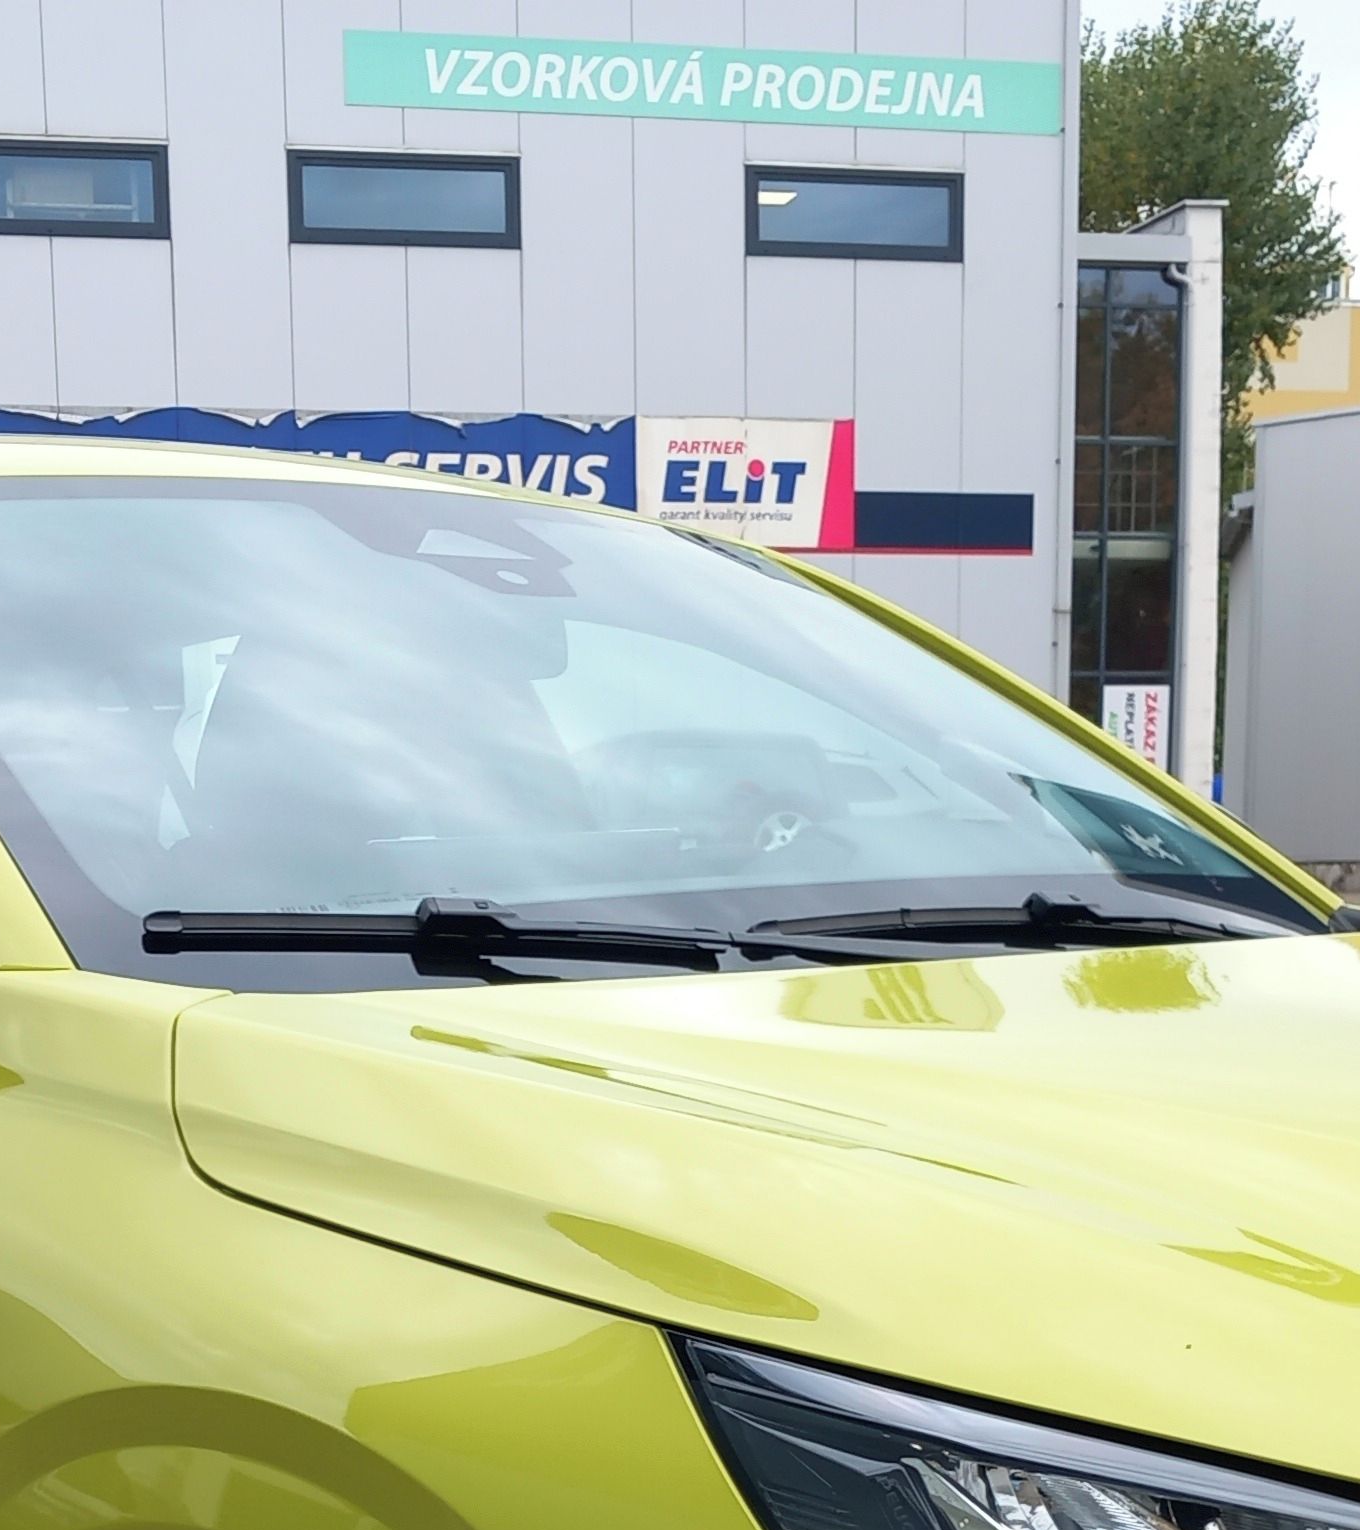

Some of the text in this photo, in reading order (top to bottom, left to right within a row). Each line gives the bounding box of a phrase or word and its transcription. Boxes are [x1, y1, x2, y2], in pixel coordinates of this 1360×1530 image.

[424, 48, 986, 118] VZORKOVÁ PRODEJNA
[668, 440, 745, 455] PARTNER
[384, 451, 609, 503] RVIS
[659, 510, 793, 523] garant kvality servisu
